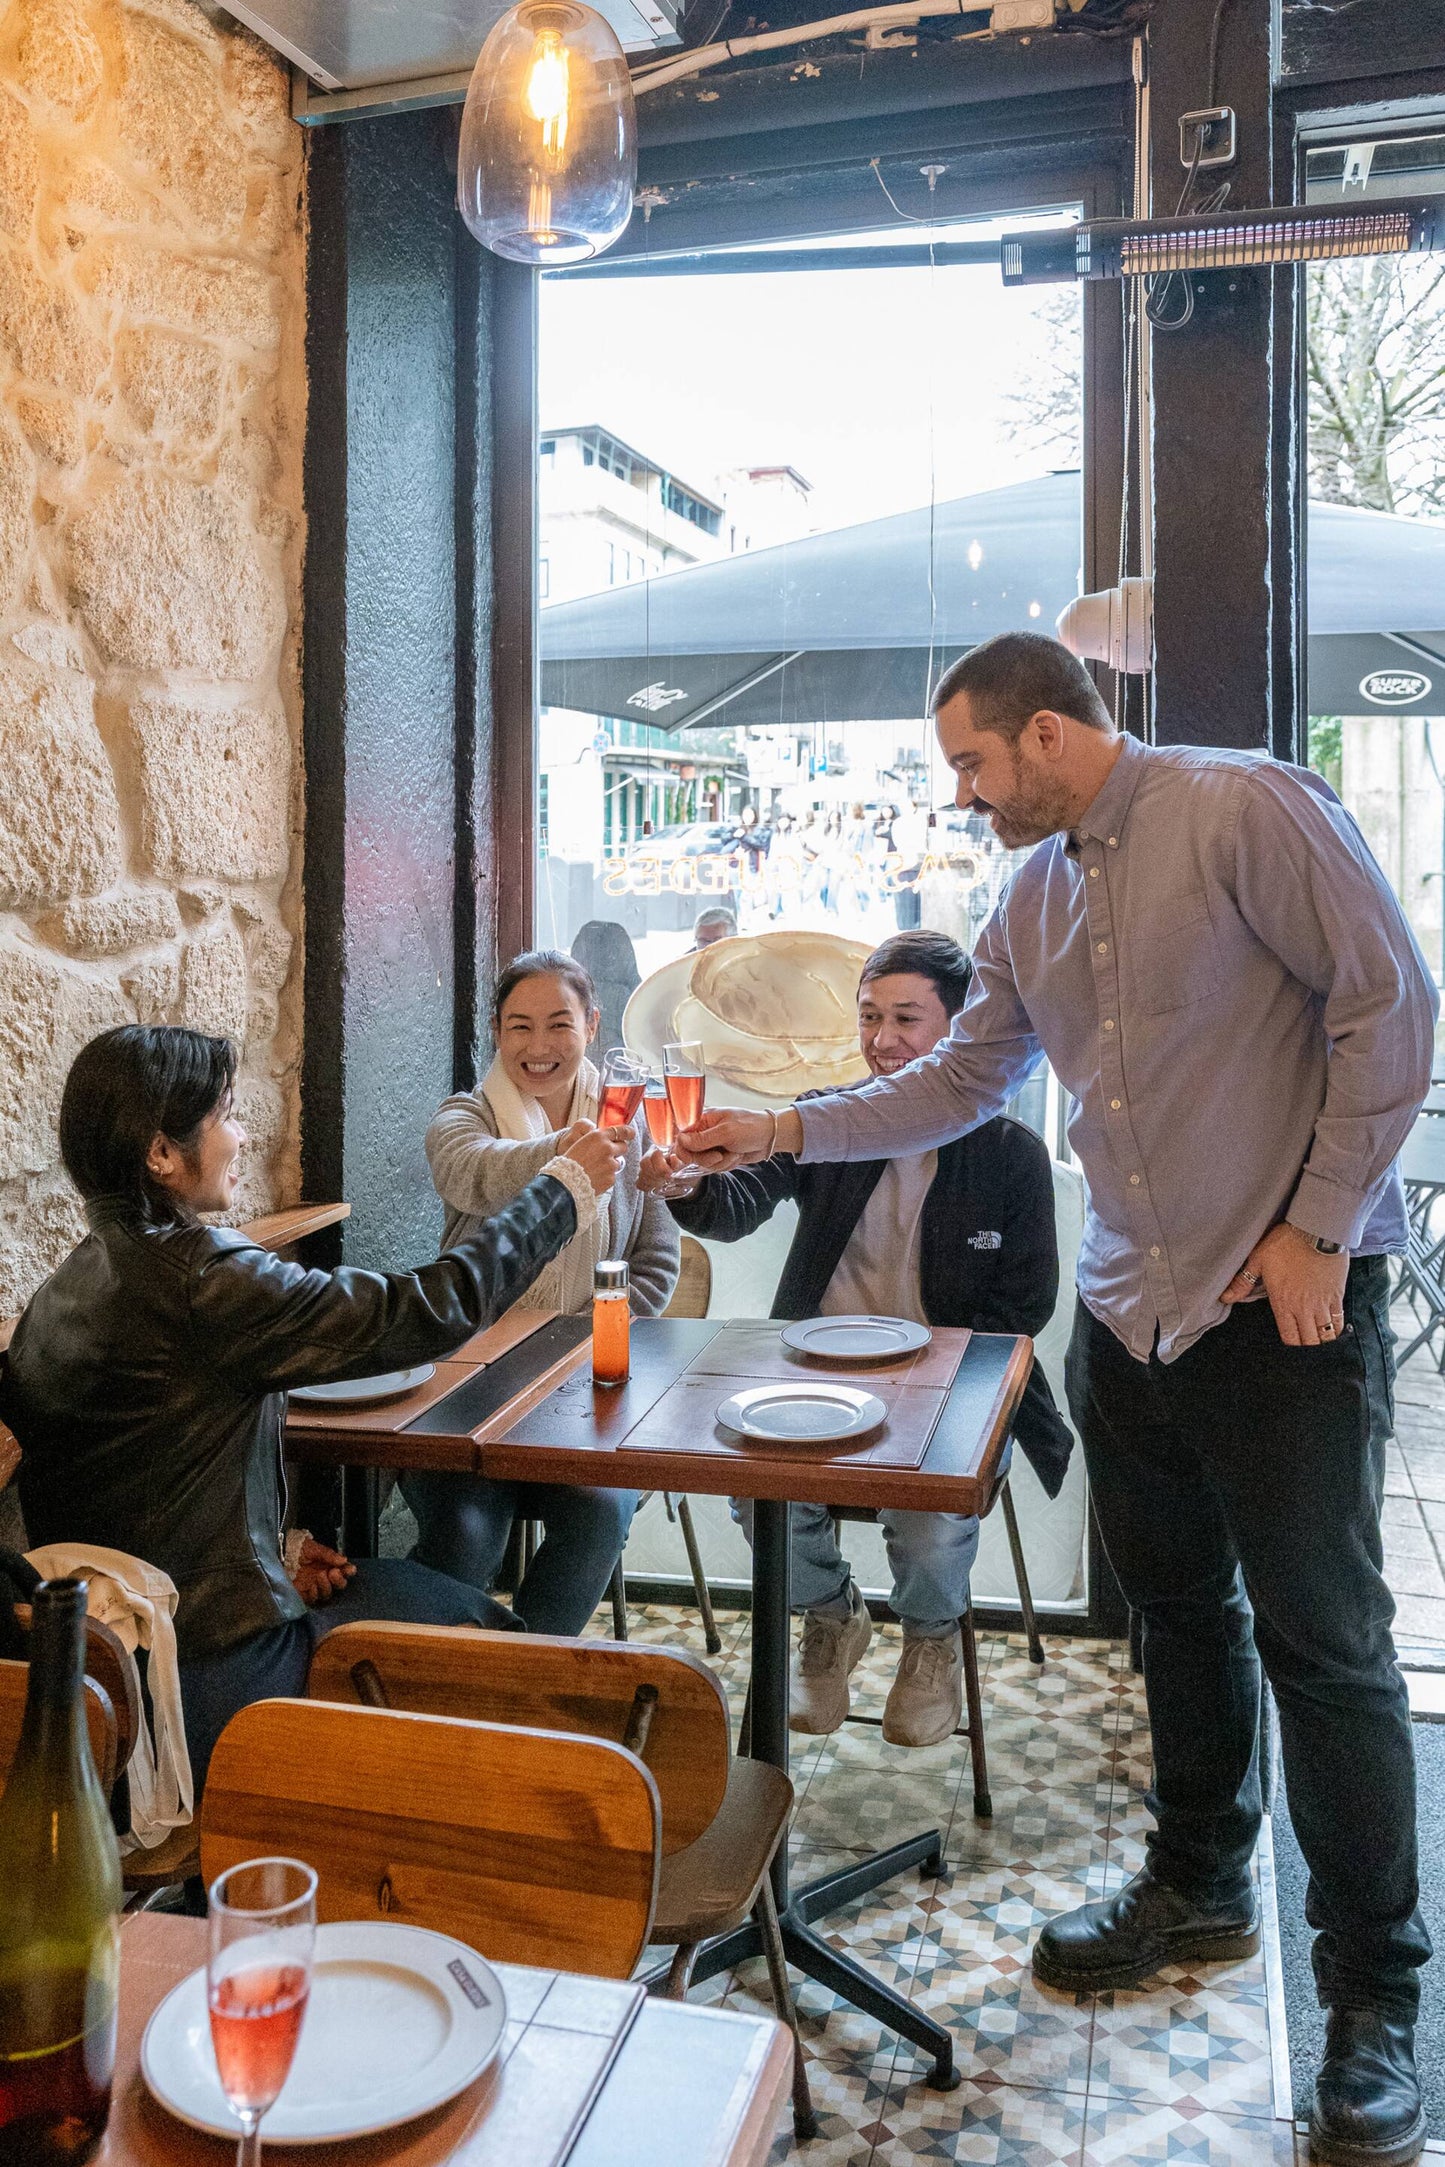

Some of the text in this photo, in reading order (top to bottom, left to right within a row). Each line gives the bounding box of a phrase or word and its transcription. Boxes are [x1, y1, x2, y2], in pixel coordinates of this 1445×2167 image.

[1369, 678, 1422, 688] SUPER
[1371, 686, 1418, 695] BOCK
[968, 1237, 993, 1245] NORTH
